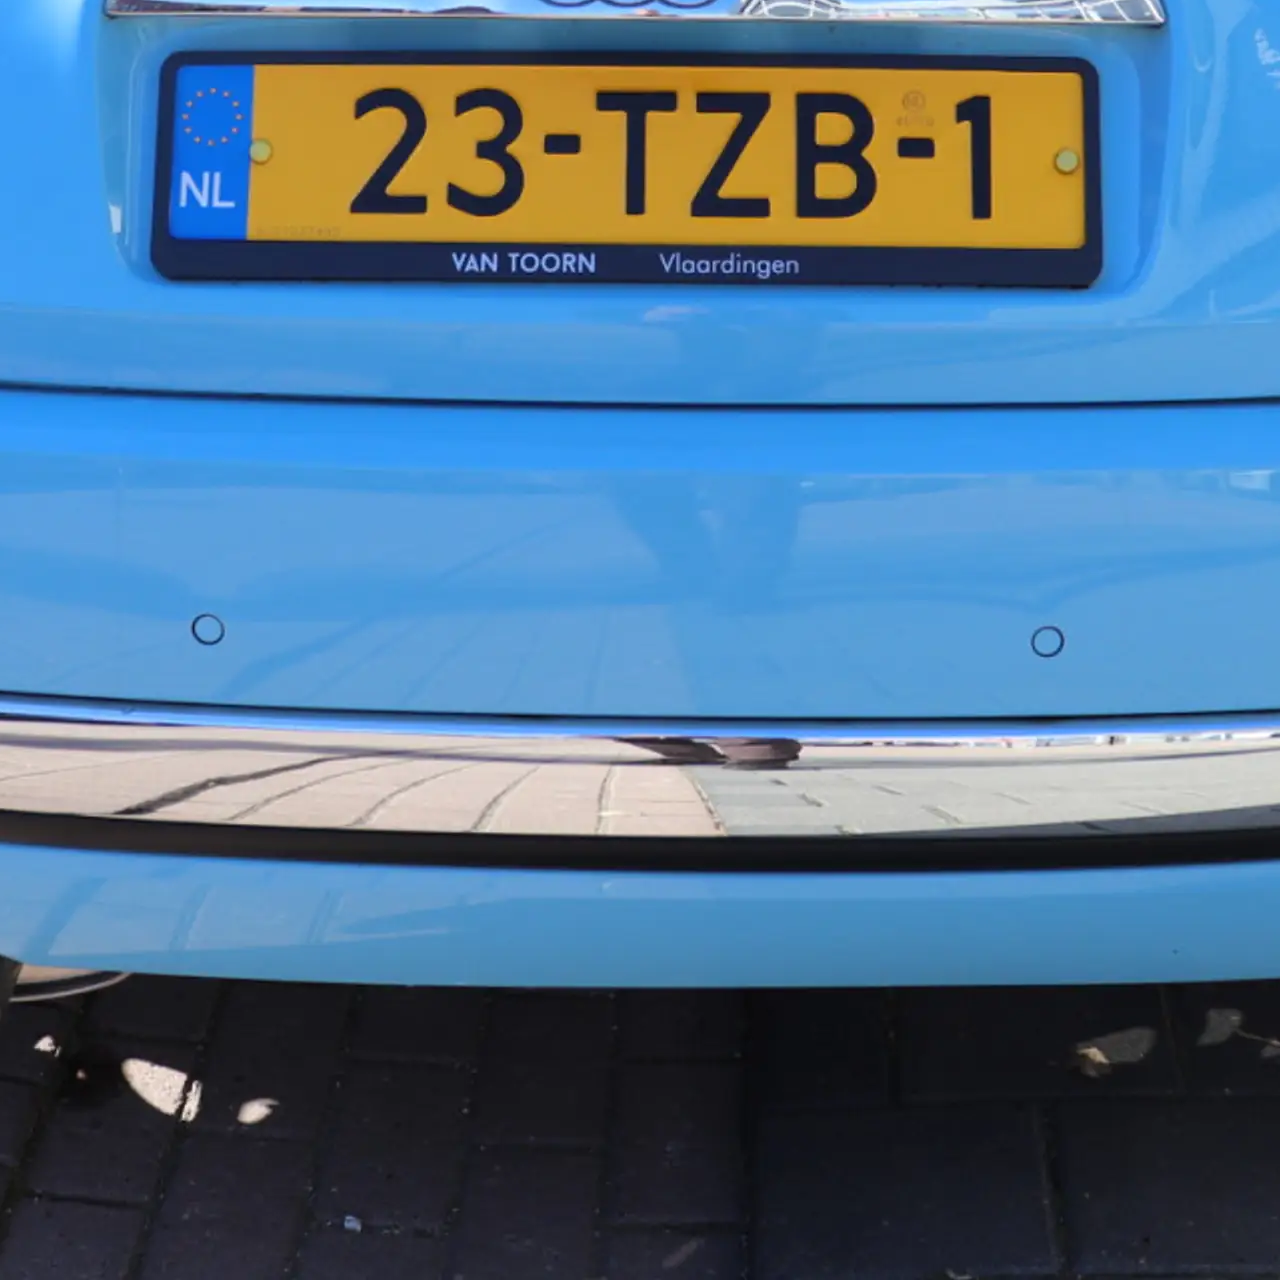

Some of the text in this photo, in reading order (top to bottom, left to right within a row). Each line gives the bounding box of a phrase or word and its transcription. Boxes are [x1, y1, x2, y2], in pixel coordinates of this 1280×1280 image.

[349, 86, 993, 220] 23-TZB-1
[178, 170, 236, 209] NL
[451, 251, 800, 279] VAN TOORN Vlaardingen
